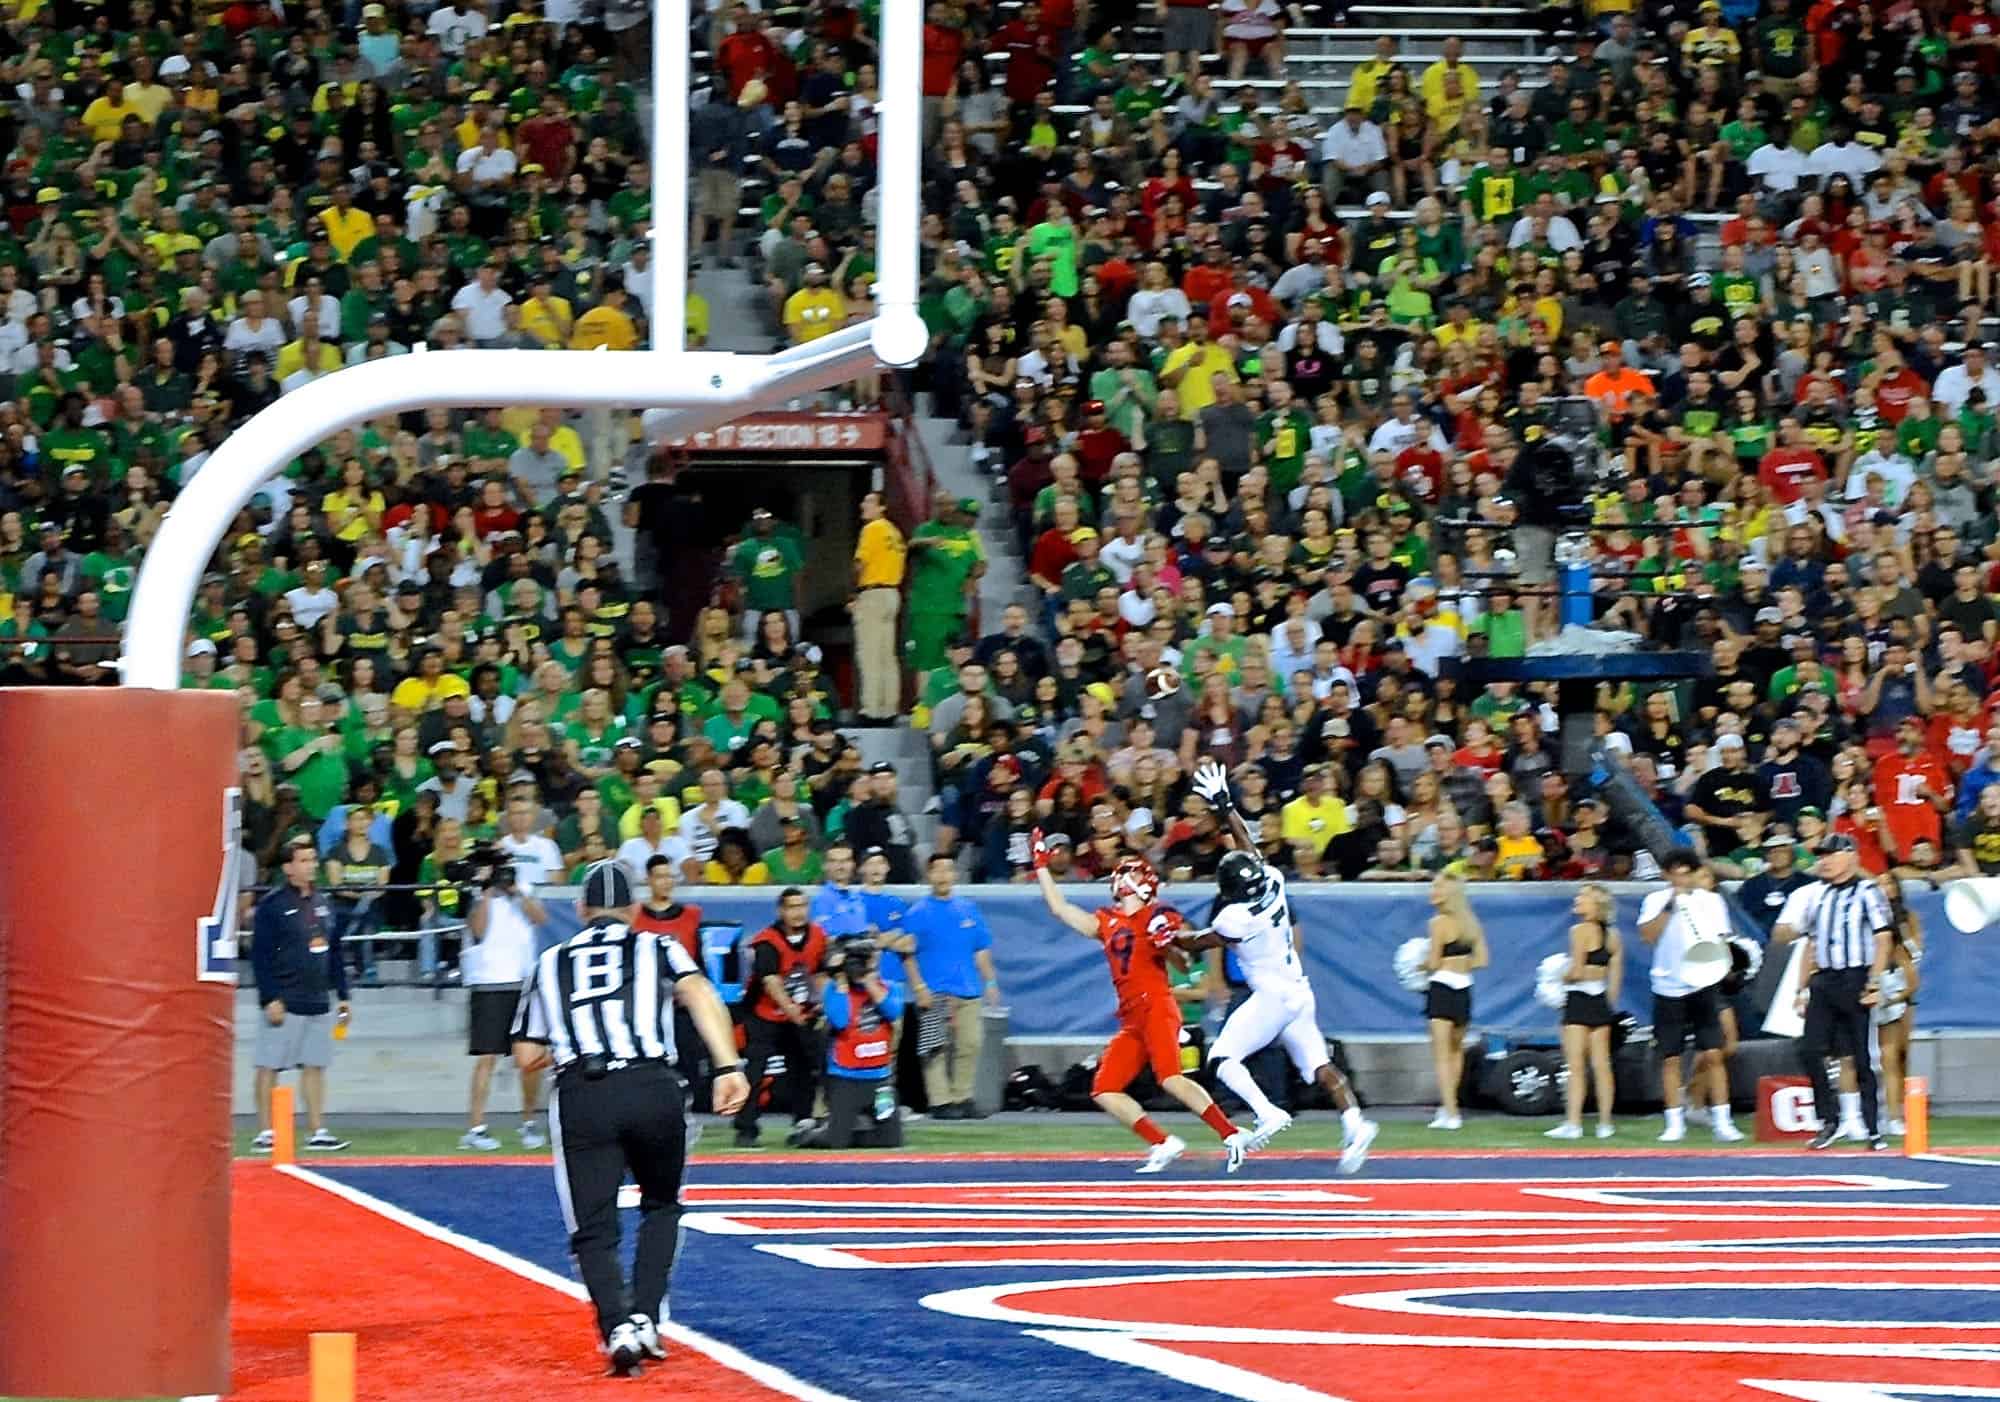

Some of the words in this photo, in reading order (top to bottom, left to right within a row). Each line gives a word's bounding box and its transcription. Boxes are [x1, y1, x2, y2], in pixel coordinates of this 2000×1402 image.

[738, 424, 815, 447] SECTION
[568, 944, 624, 1002] B
[1110, 927, 1135, 976] 9
[1770, 1085, 1825, 1133] G
